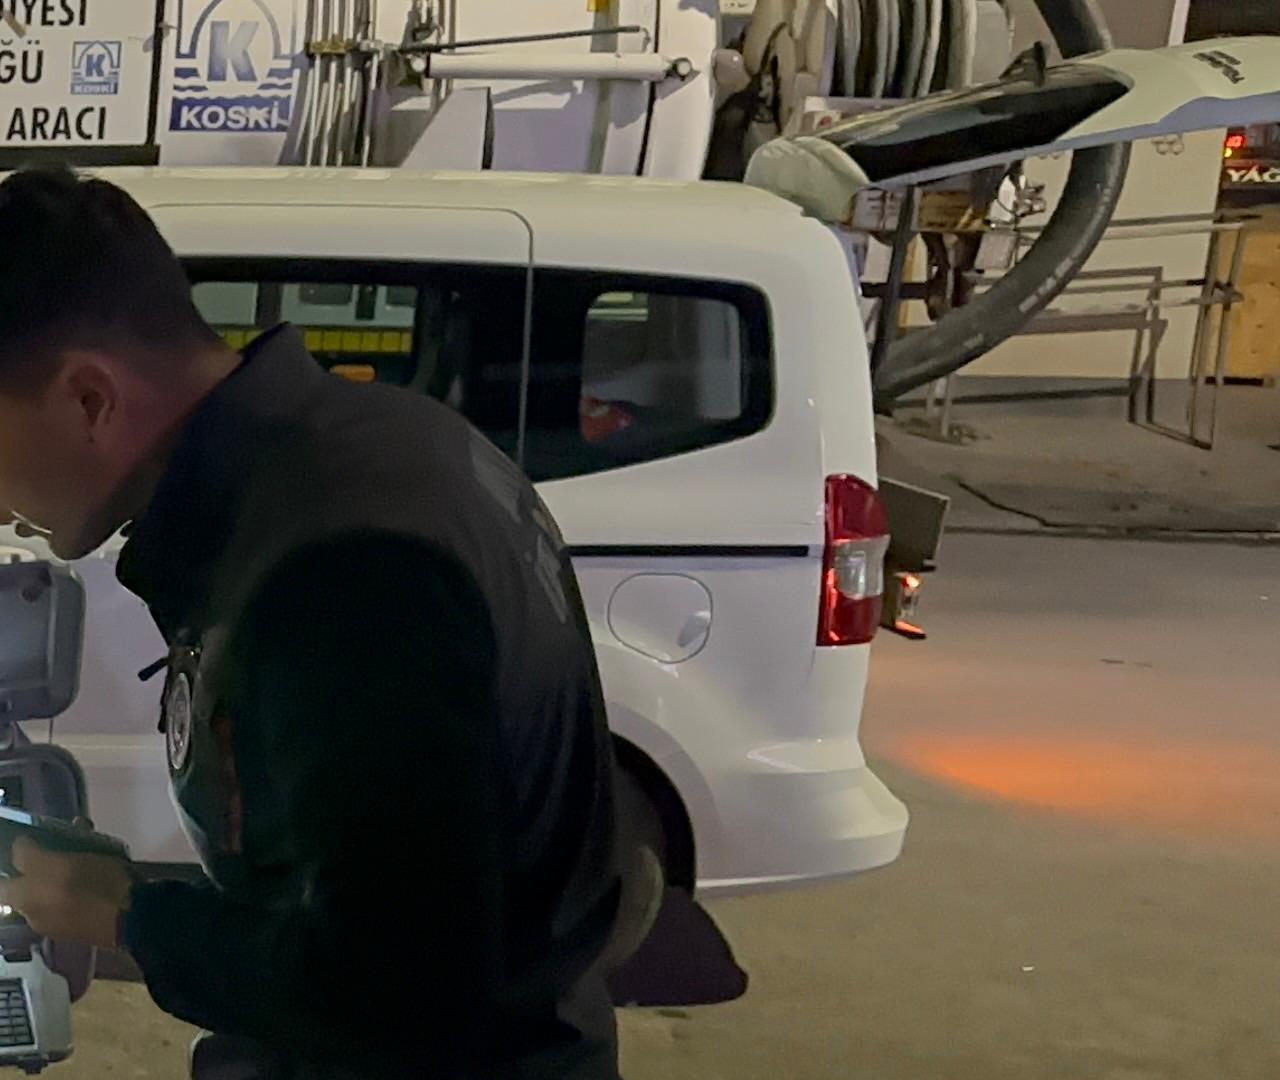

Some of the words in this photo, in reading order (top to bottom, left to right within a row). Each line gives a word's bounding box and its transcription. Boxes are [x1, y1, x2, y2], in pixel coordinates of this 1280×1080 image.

[207, 20, 260, 82] K
[5, 107, 107, 141] ARACI
[179, 101, 279, 130] KOSKİ
